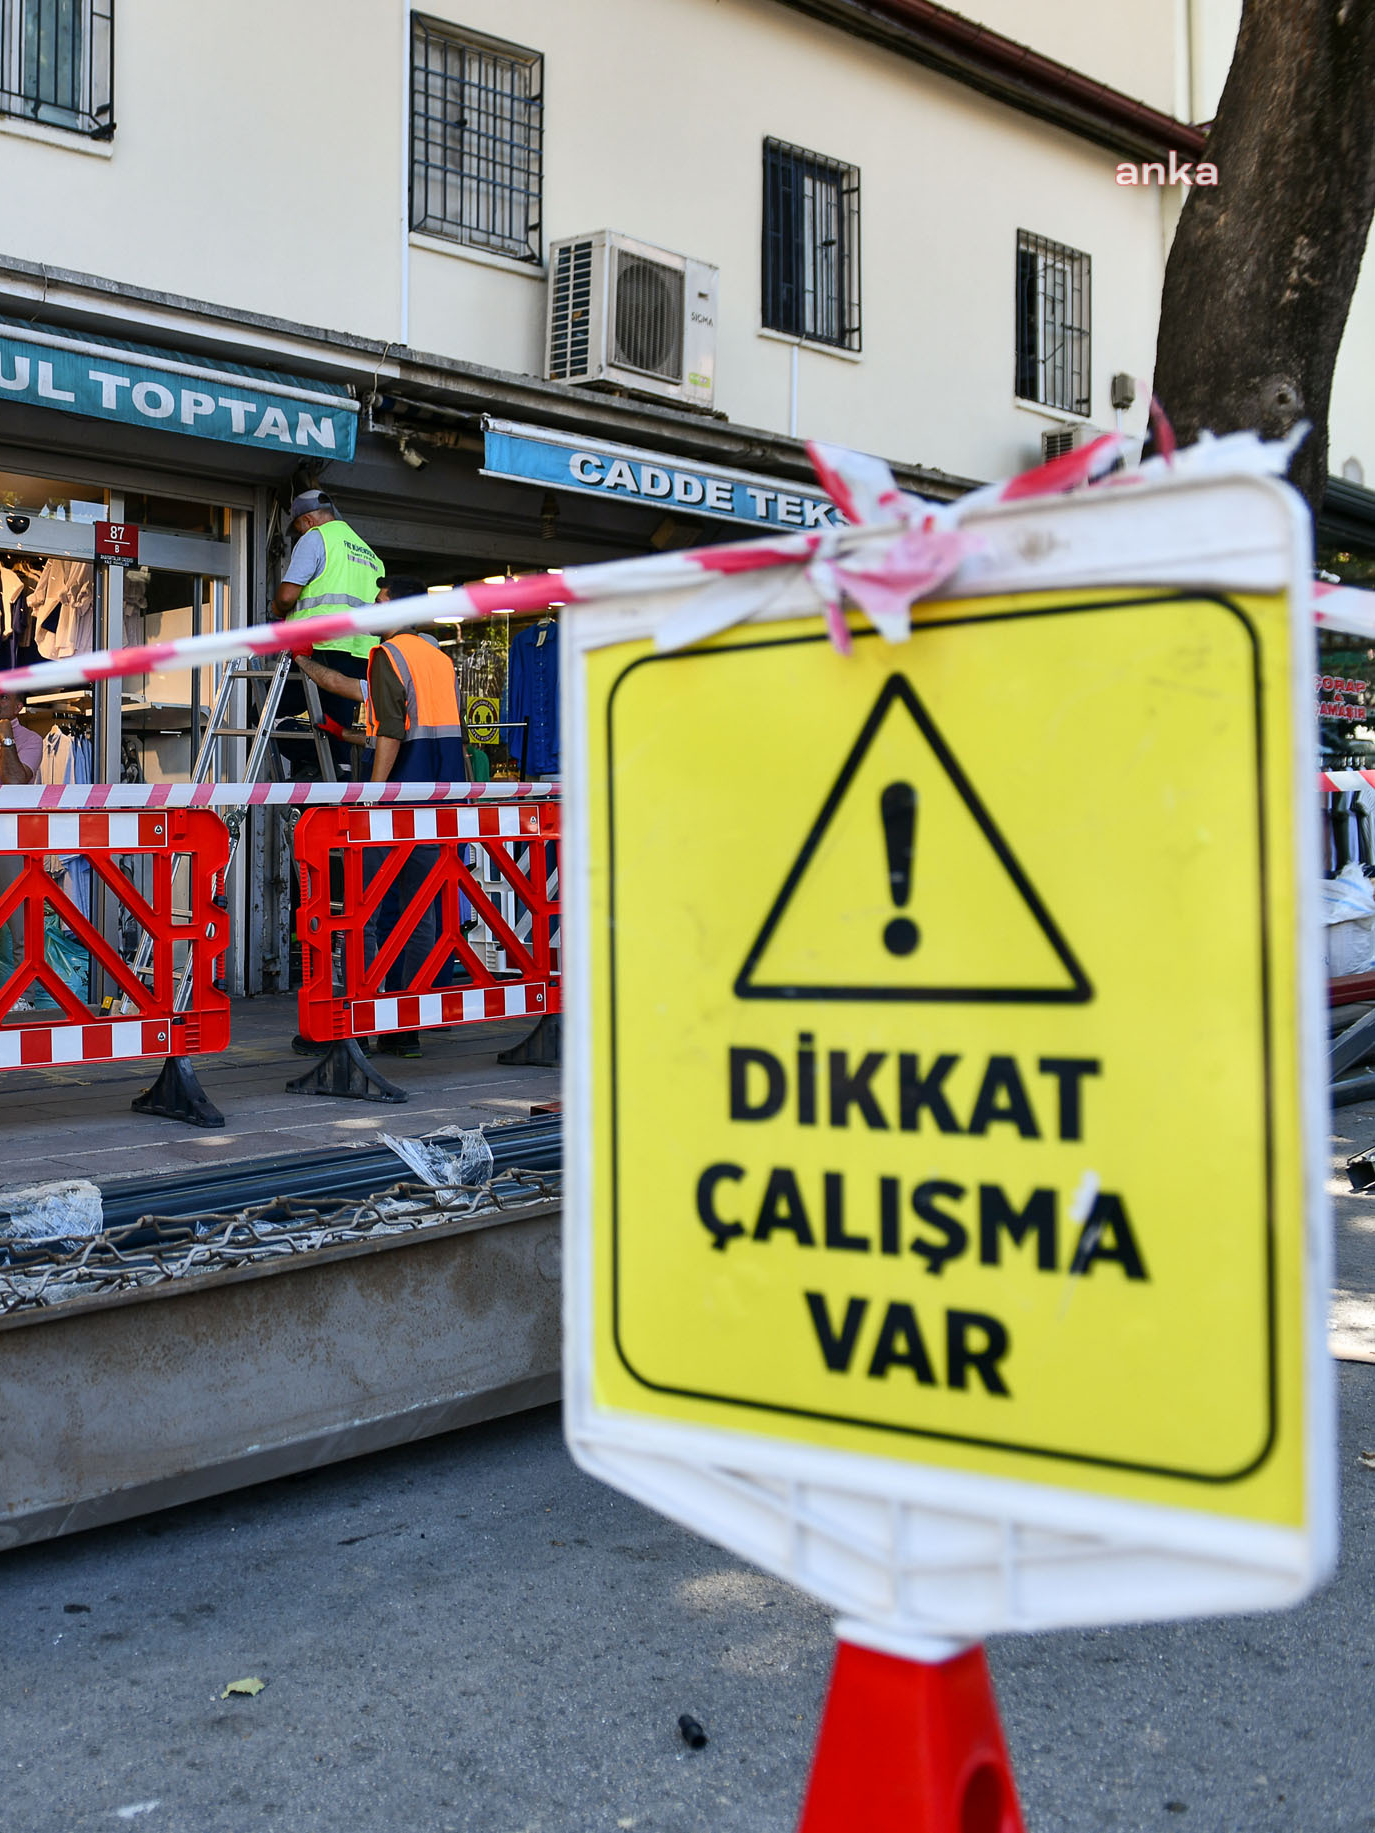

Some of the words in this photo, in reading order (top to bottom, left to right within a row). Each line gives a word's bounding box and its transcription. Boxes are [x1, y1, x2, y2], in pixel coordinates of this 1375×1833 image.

[691, 312, 713, 327] SIGMA
[89, 370, 336, 449] TOPTAN
[569, 452, 735, 512] CADDE
[110, 525, 125, 540] 87
[727, 1031, 1102, 1142] DİKKAT
[696, 1162, 1151, 1281] ÇALIŞMA
[804, 1291, 1013, 1399] VAR
